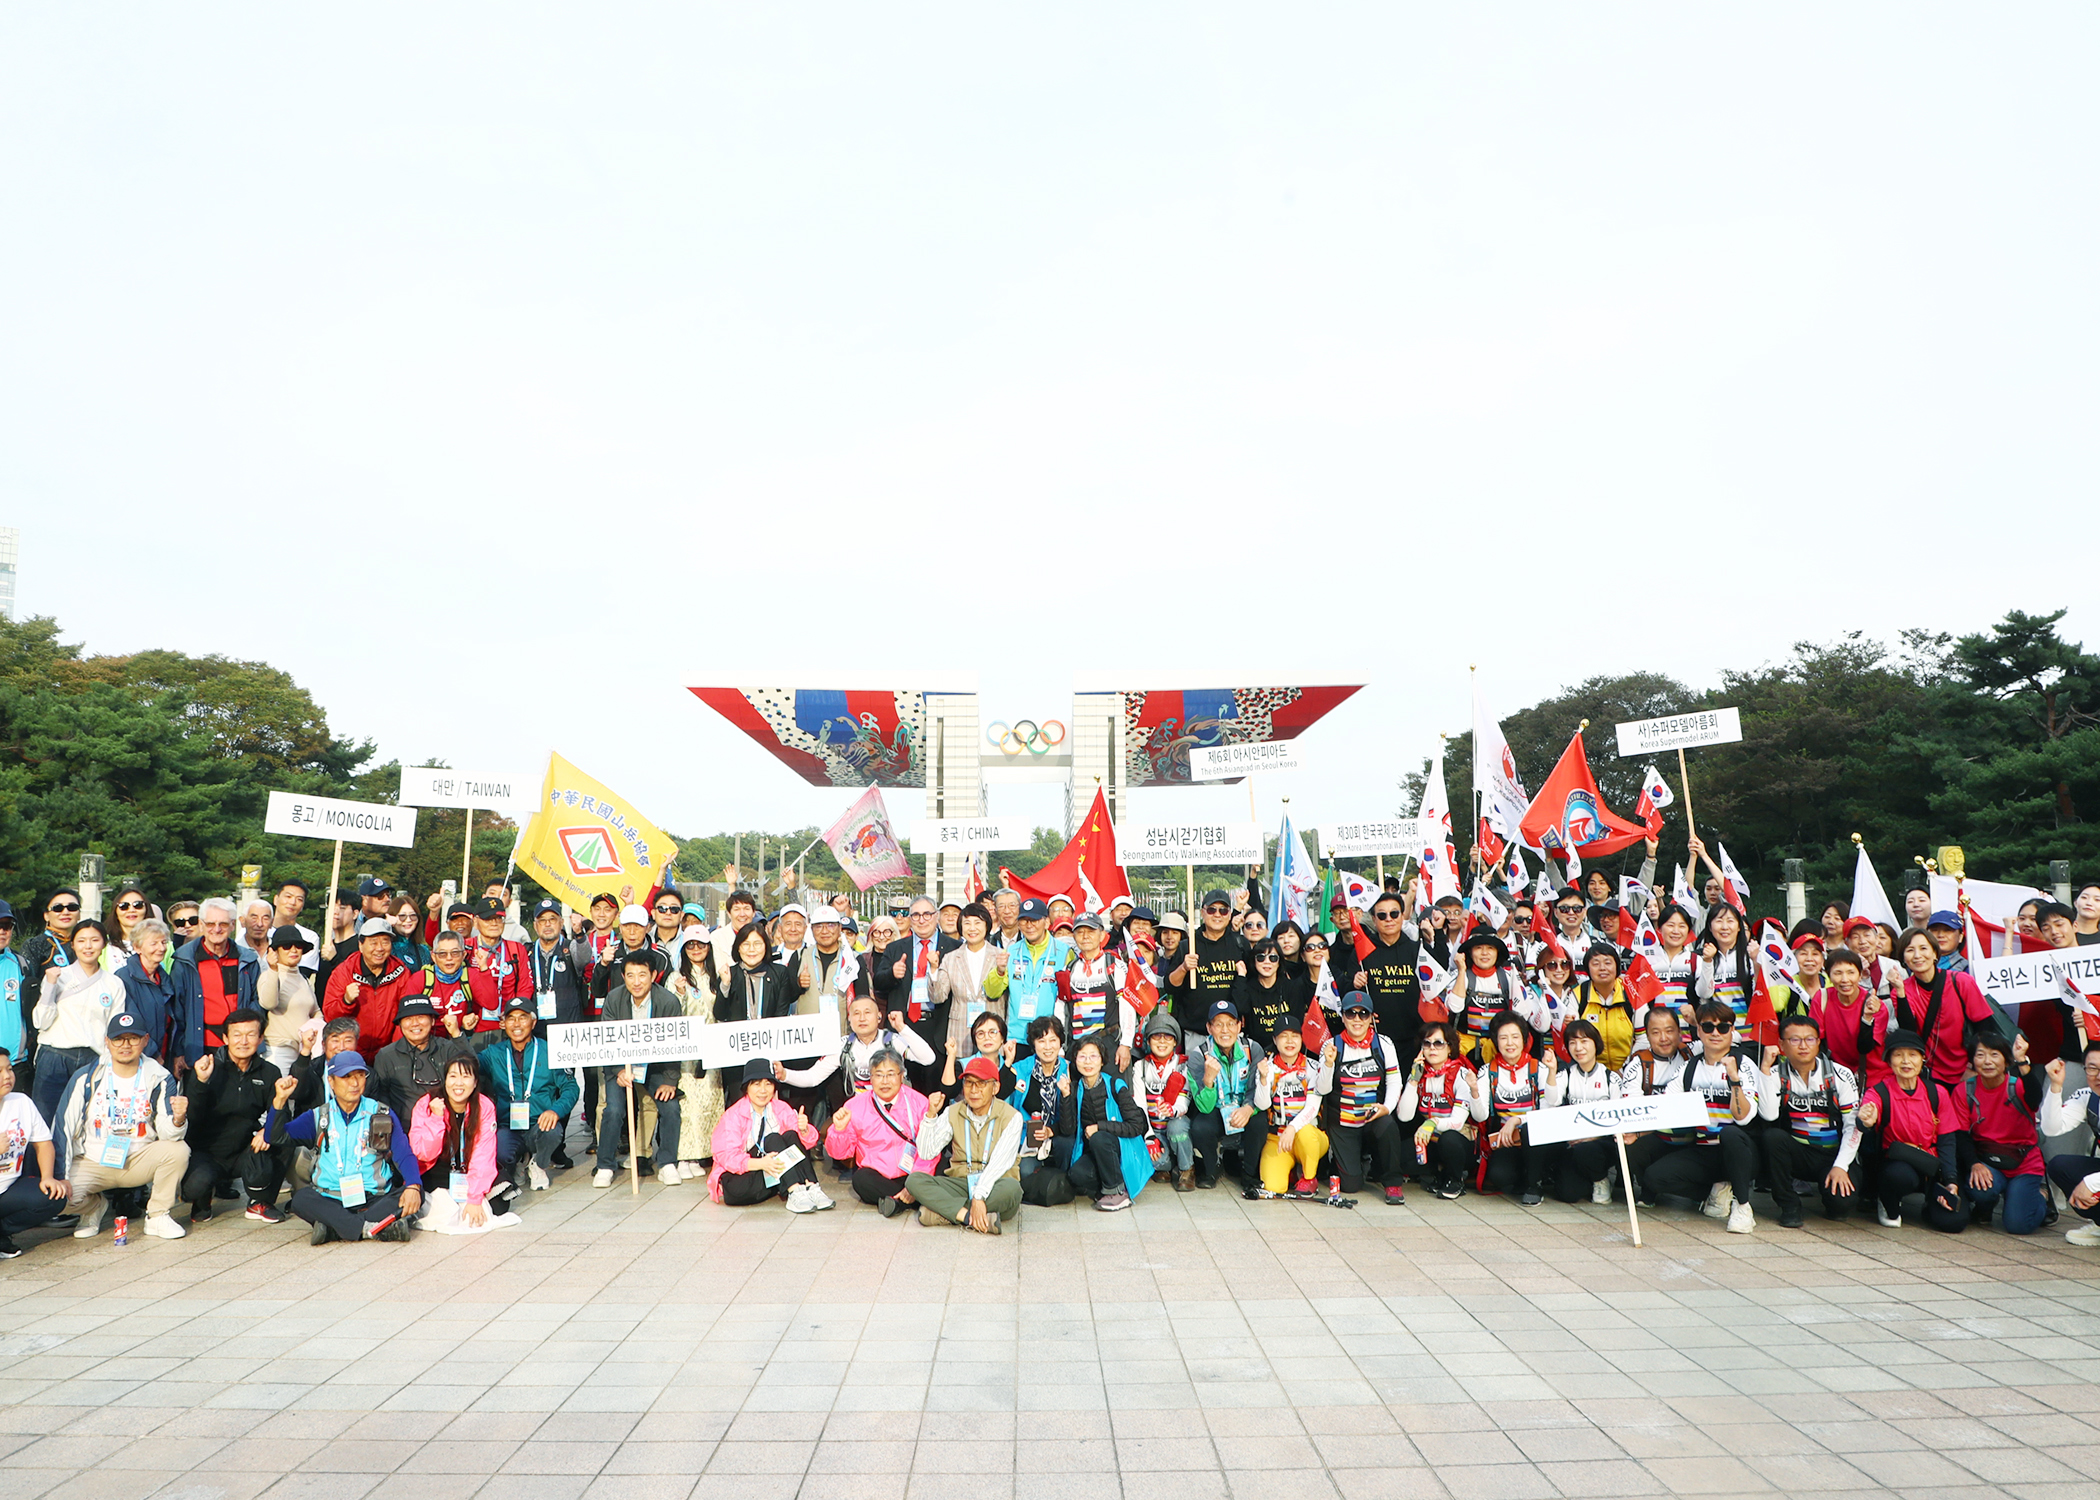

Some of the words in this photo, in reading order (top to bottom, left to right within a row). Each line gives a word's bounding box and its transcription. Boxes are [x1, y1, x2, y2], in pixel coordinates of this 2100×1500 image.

[1638, 713, 1719, 739] 사)슈퍼모델아름회
[1640, 740, 1660, 749] Korea
[1660, 735, 1700, 747] Supermodel
[1700, 731, 1720, 740] ARUM
[1208, 748, 1232, 765] 제6회
[1233, 743, 1289, 762] 아시안피아드
[1200, 767, 1212, 776] The
[1262, 761, 1279, 770] Seoul
[1279, 760, 1298, 769] Korea
[432, 778, 455, 797] 대만
[465, 781, 511, 798] TAIWAN
[291, 804, 315, 824] 몽고
[325, 809, 393, 832] MONGOLIA
[940, 827, 959, 843] 중국
[967, 826, 1000, 840] CHINA
[1145, 826, 1226, 846] 성남시걷기협회
[1337, 824, 1361, 841] 제30회
[1122, 850, 1163, 862] Seongnam
[1164, 849, 1179, 862] City
[1180, 849, 1212, 862] Walking
[1213, 847, 1258, 859] Association
[547, 866, 565, 883] Taipei
[565, 880, 586, 897] Alpine
[1196, 966, 1209, 974] We
[1201, 973, 1235, 984] Together
[1369, 967, 1383, 976] We
[1986, 966, 2030, 990] 스위스
[562, 1019, 690, 1050] 사)서귀포시관광협의회
[728, 1028, 773, 1053] 이탈리아
[782, 1026, 815, 1047] ITALY
[556, 1051, 598, 1065] Seogwipo
[598, 1049, 615, 1062] City
[616, 1046, 650, 1059] Tourism
[651, 1043, 699, 1056] Association
